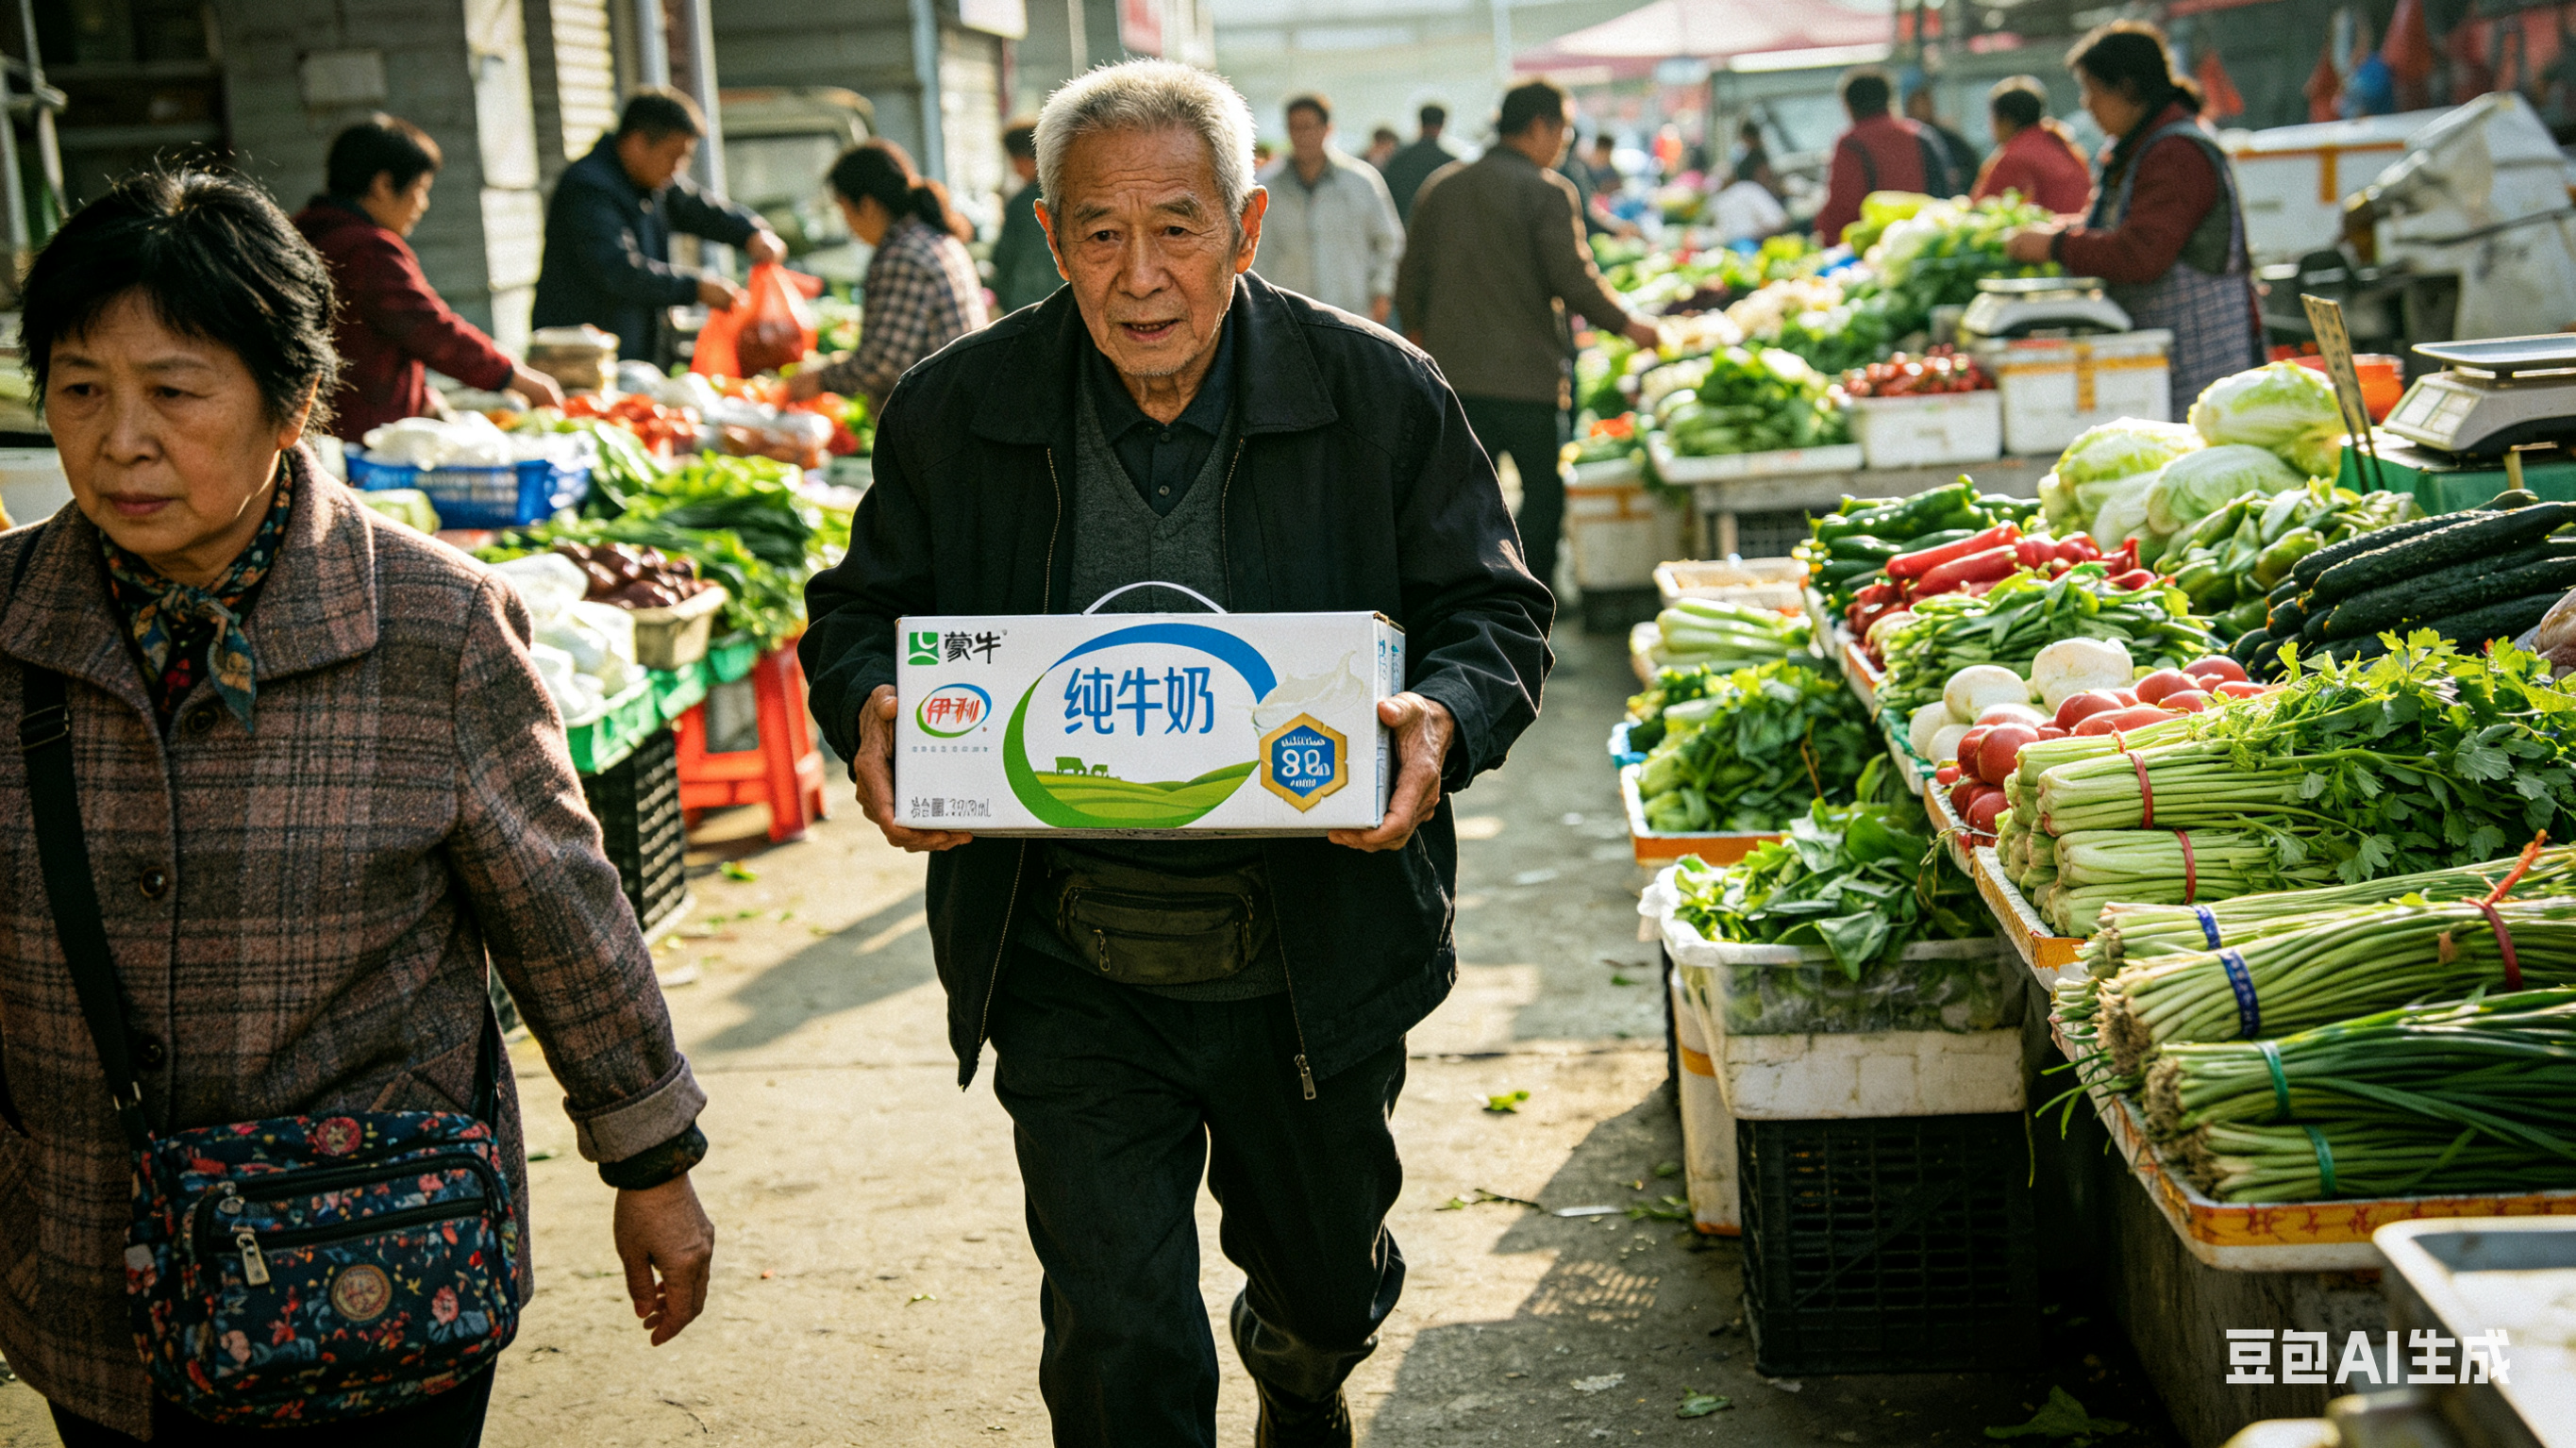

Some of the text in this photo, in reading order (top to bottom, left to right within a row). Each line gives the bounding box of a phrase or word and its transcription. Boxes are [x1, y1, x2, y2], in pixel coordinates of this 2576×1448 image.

[945, 630, 1001, 664] 蒙牛
[1063, 666, 1214, 737] 纯牛奶
